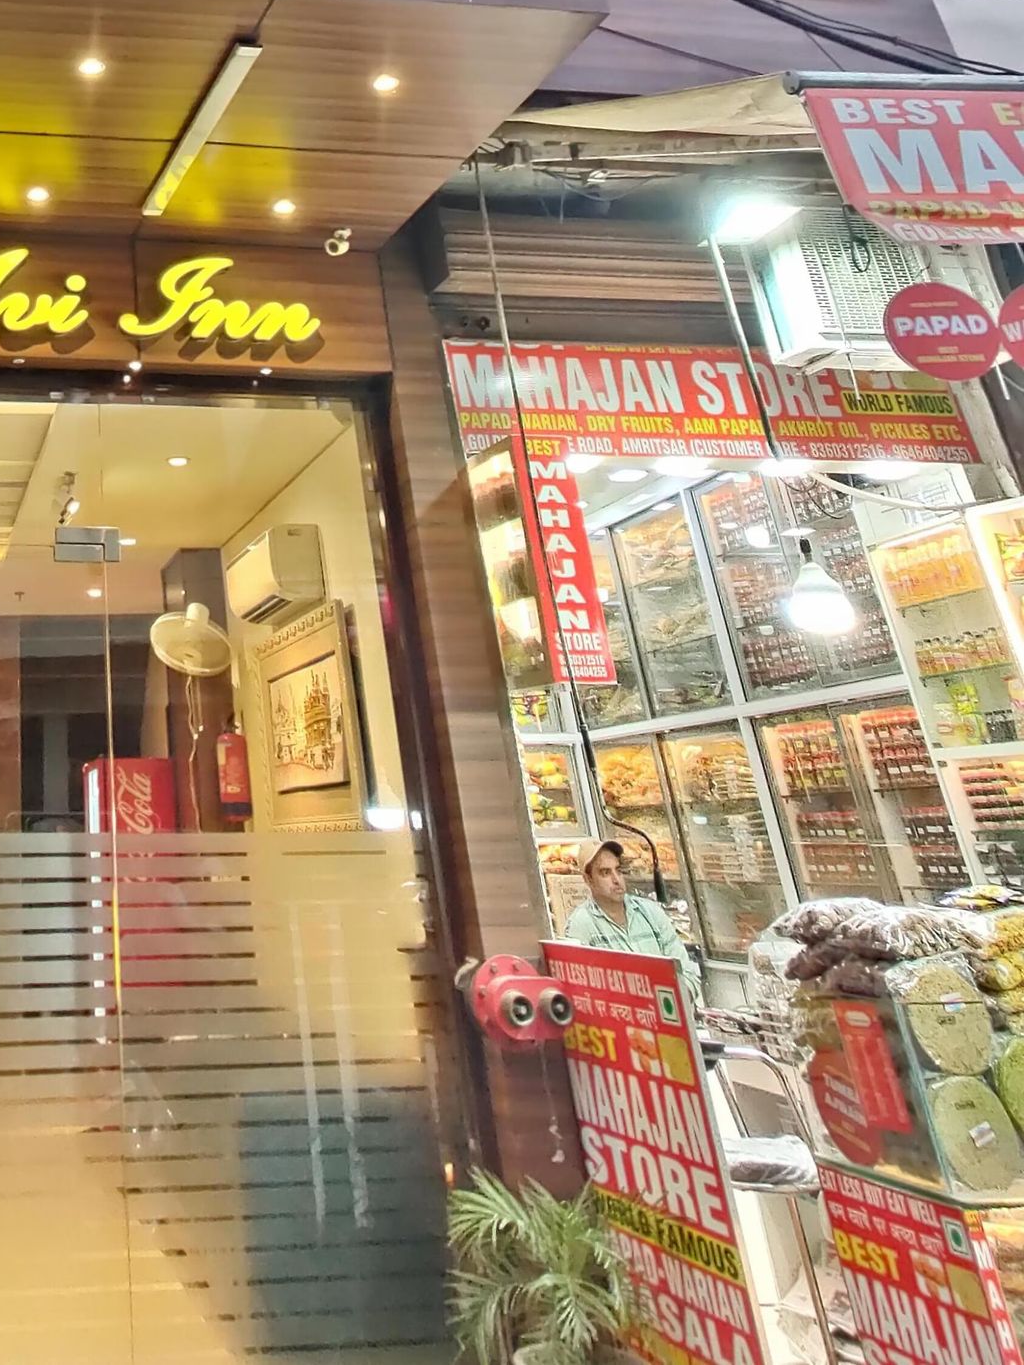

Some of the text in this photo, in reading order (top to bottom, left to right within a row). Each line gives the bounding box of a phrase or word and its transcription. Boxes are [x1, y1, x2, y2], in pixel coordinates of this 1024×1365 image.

[831, 98, 1024, 126] BEST E
[842, 128, 1024, 195] MA
[119, 256, 321, 343] Inn
[892, 314, 989, 338] PAPAD
[1001, 320, 1024, 343] W
[451, 353, 843, 419] MAHAJAN STORE
[842, 392, 955, 416] WORLD FAMOUS
[525, 439, 562, 457] BEST
[586, 416, 616, 432] DRY
[683, 419, 715, 435] AAM
[720, 419, 765, 437] PAPA
[871, 423, 931, 441] PICKLES
[622, 440, 689, 457] AMRITSAR
[529, 461, 590, 630] MAHAJAN
[555, 632, 603, 651] STORE
[549, 960, 654, 999] EAT LESS BUT EAT WELL
[563, 1023, 617, 1062] BEST
[567, 1057, 714, 1168] MAHAJAN
[580, 1124, 730, 1238] STORE
[819, 1169, 838, 1192] EAT
[837, 1173, 865, 1202] LESS
[862, 1181, 886, 1210] BUT
[885, 1189, 908, 1217] EAT
[906, 1193, 942, 1228] WELL
[655, 1217, 740, 1281] FAMOUS
[832, 1227, 900, 1282] BEST
[842, 1265, 1005, 1365] MAHAJAN
[971, 1239, 1019, 1365] MAH
